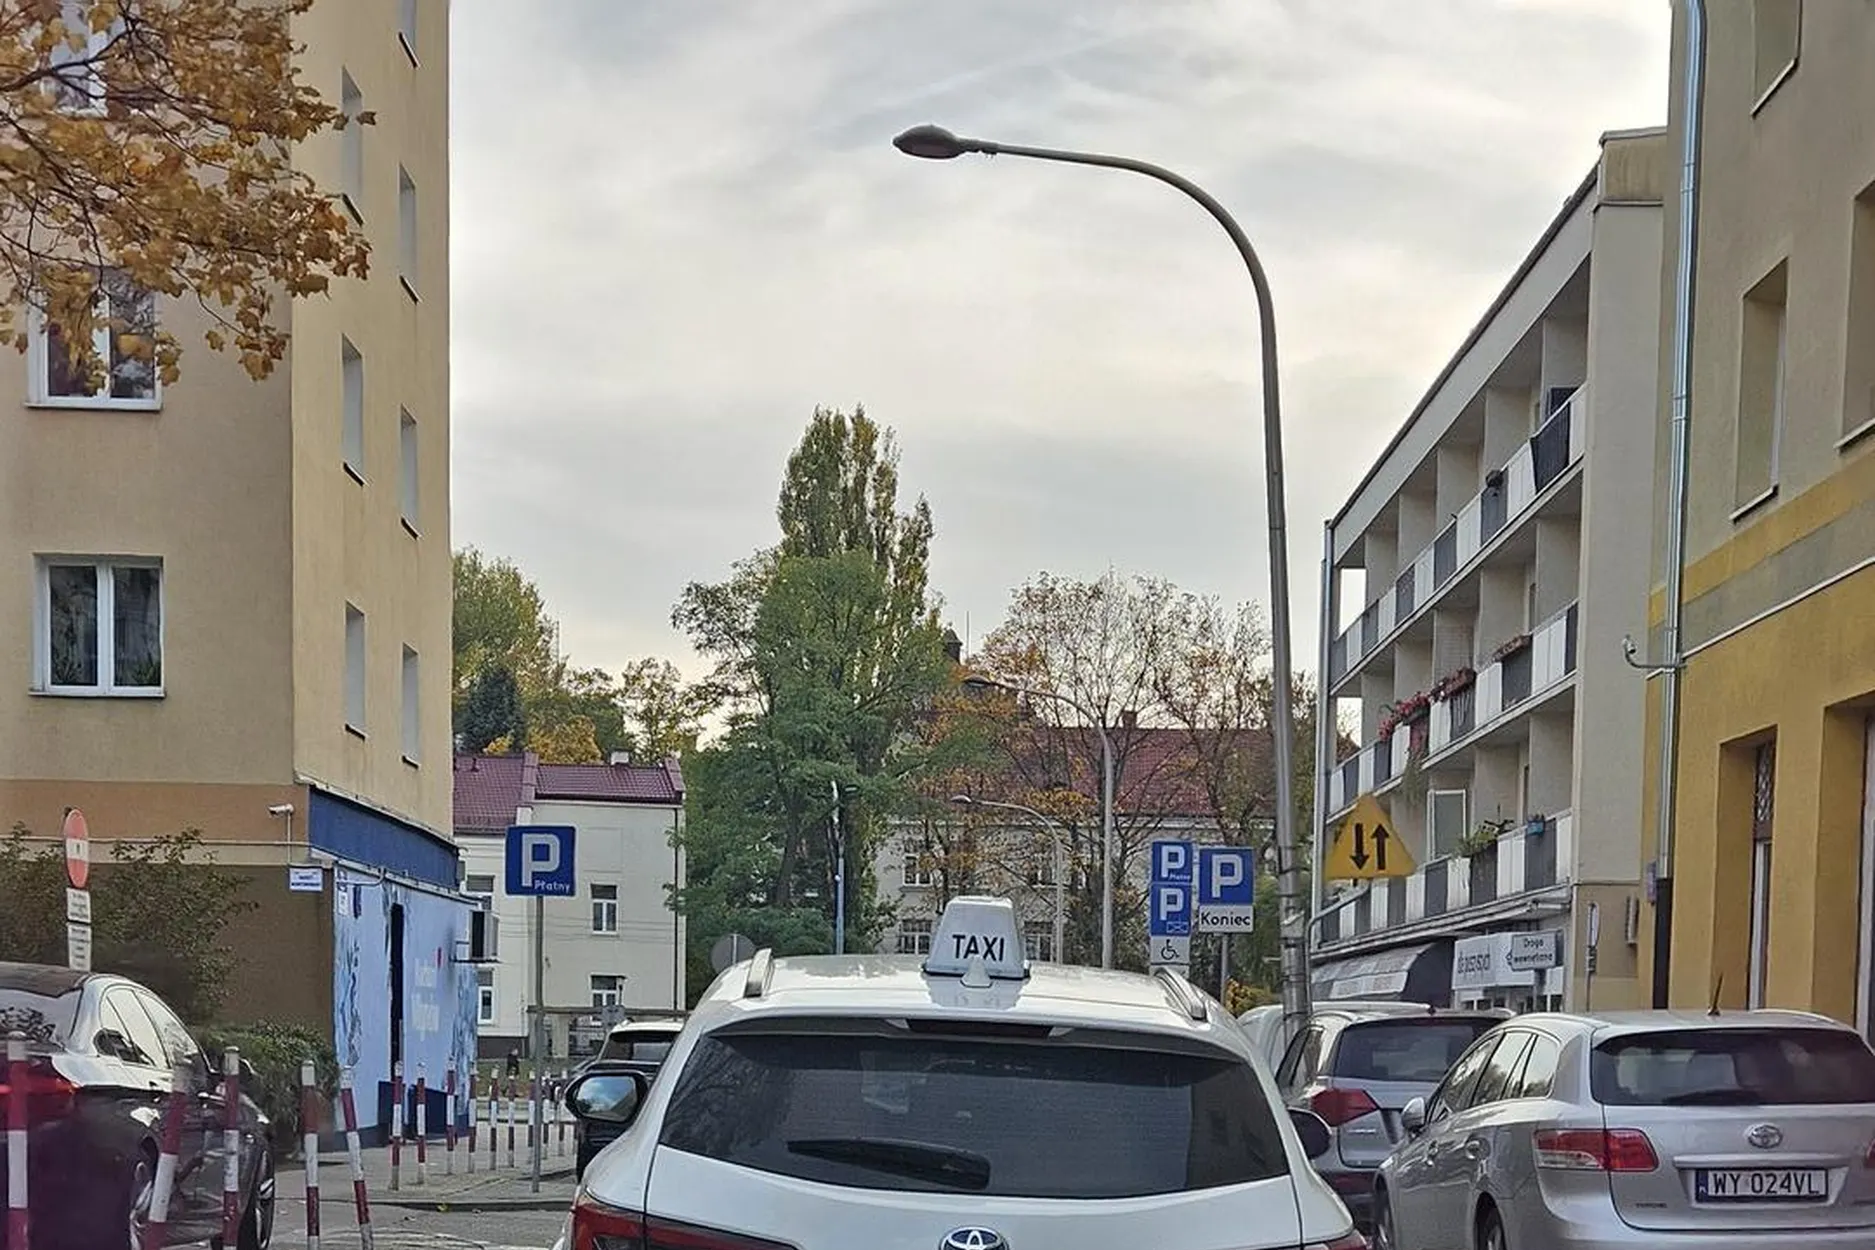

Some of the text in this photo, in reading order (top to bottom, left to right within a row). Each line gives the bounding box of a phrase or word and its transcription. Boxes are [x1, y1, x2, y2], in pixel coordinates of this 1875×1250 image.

[522, 833, 560, 887] P
[1161, 845, 1185, 878] P
[1211, 854, 1243, 898] P
[1160, 888, 1184, 920] P
[1200, 911, 1251, 926] Koniec
[952, 934, 1005, 961] TAXI
[1713, 1172, 1820, 1195] WY 024VL
